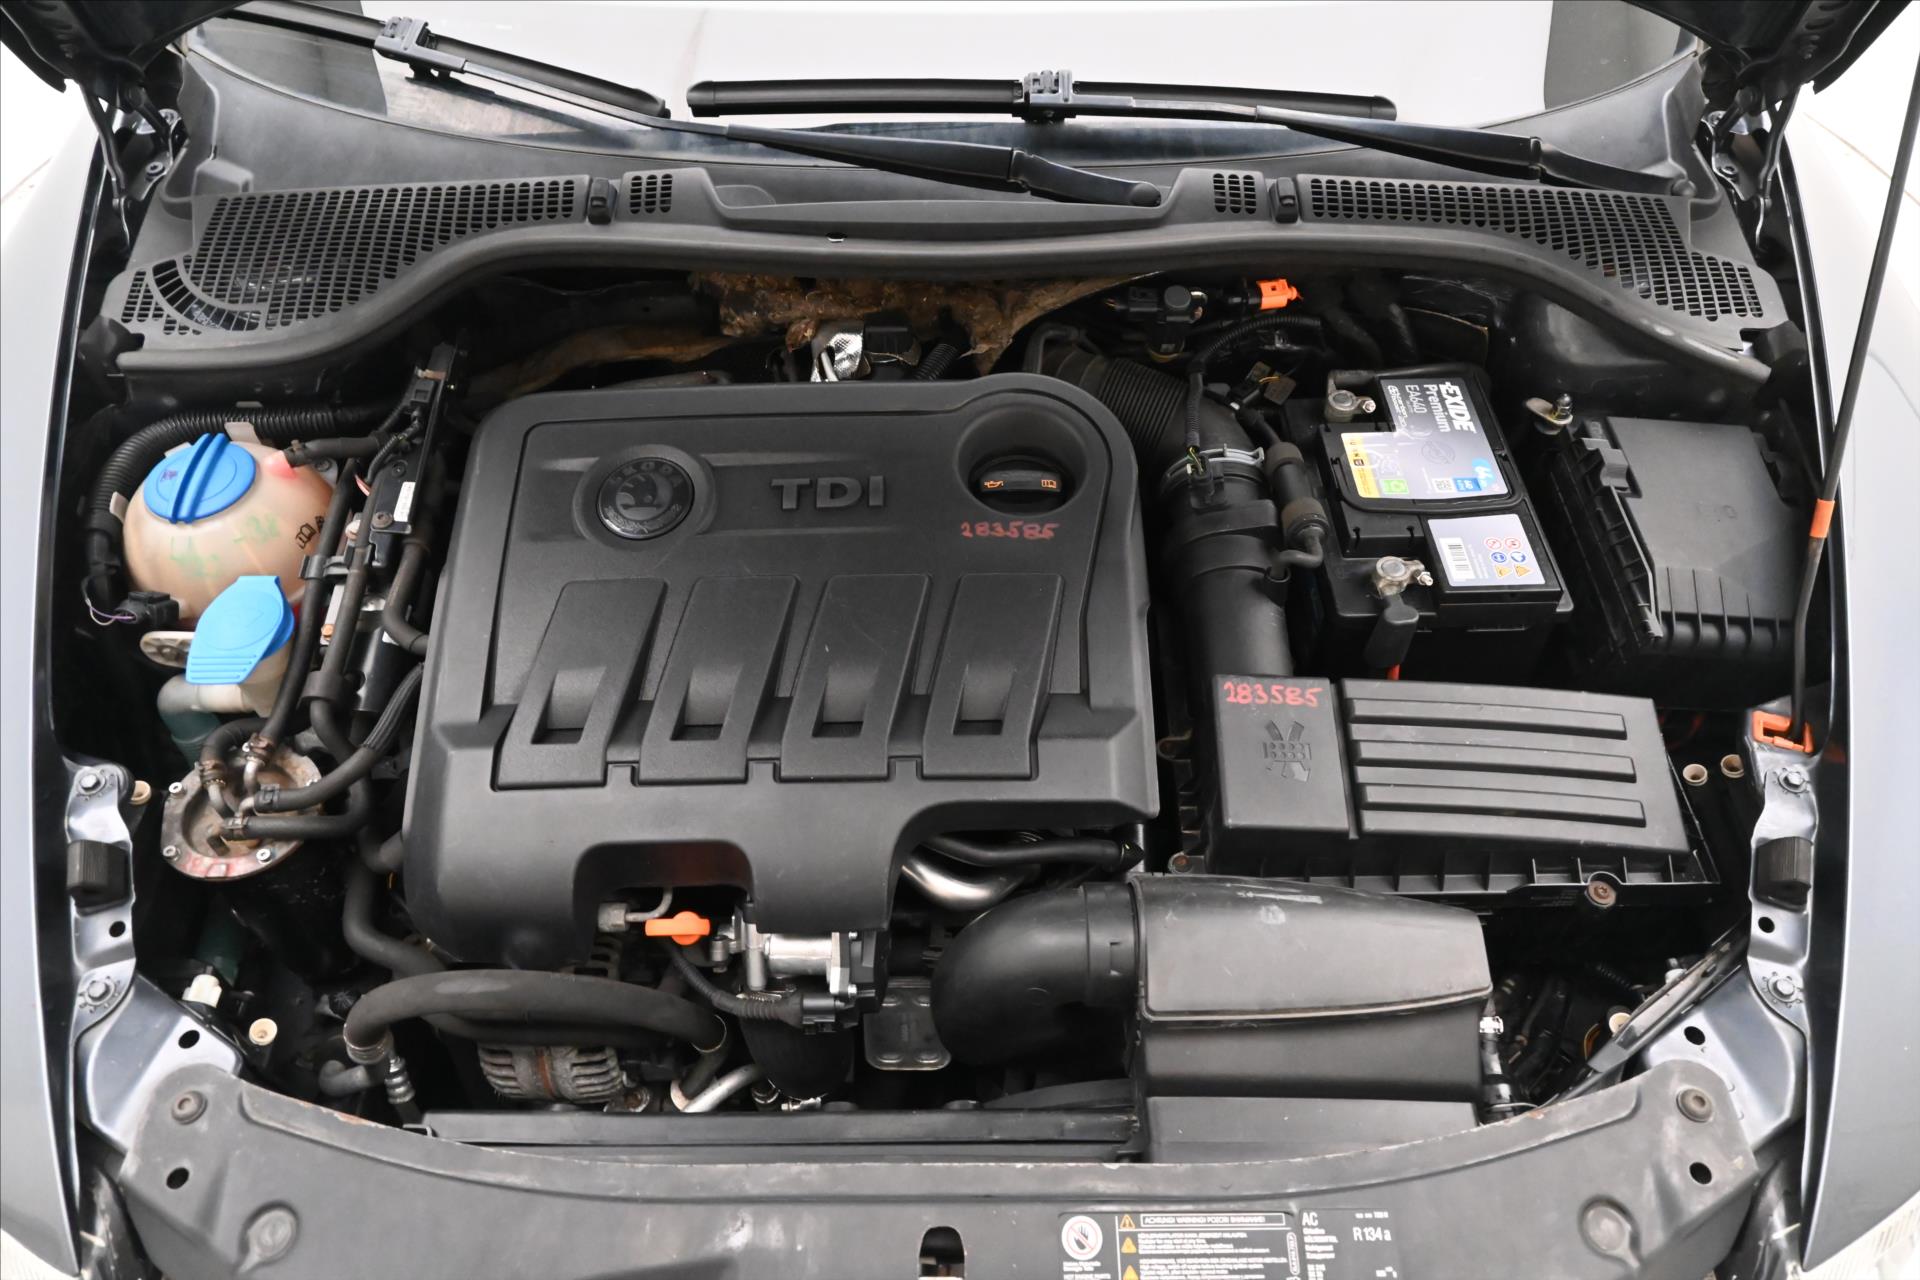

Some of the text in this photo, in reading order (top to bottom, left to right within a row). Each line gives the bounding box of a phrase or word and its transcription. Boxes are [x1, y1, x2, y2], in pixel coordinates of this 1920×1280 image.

[1405, 384, 1428, 414] EA640
[1423, 384, 1450, 432] Premium
[1439, 381, 1476, 434] EXIDE
[770, 474, 885, 509] TDI
[1302, 1212, 1318, 1226] AC
[1352, 1227, 1363, 1241] R
[1363, 1227, 1383, 1241] 134
[1383, 1229, 1392, 1241] a
